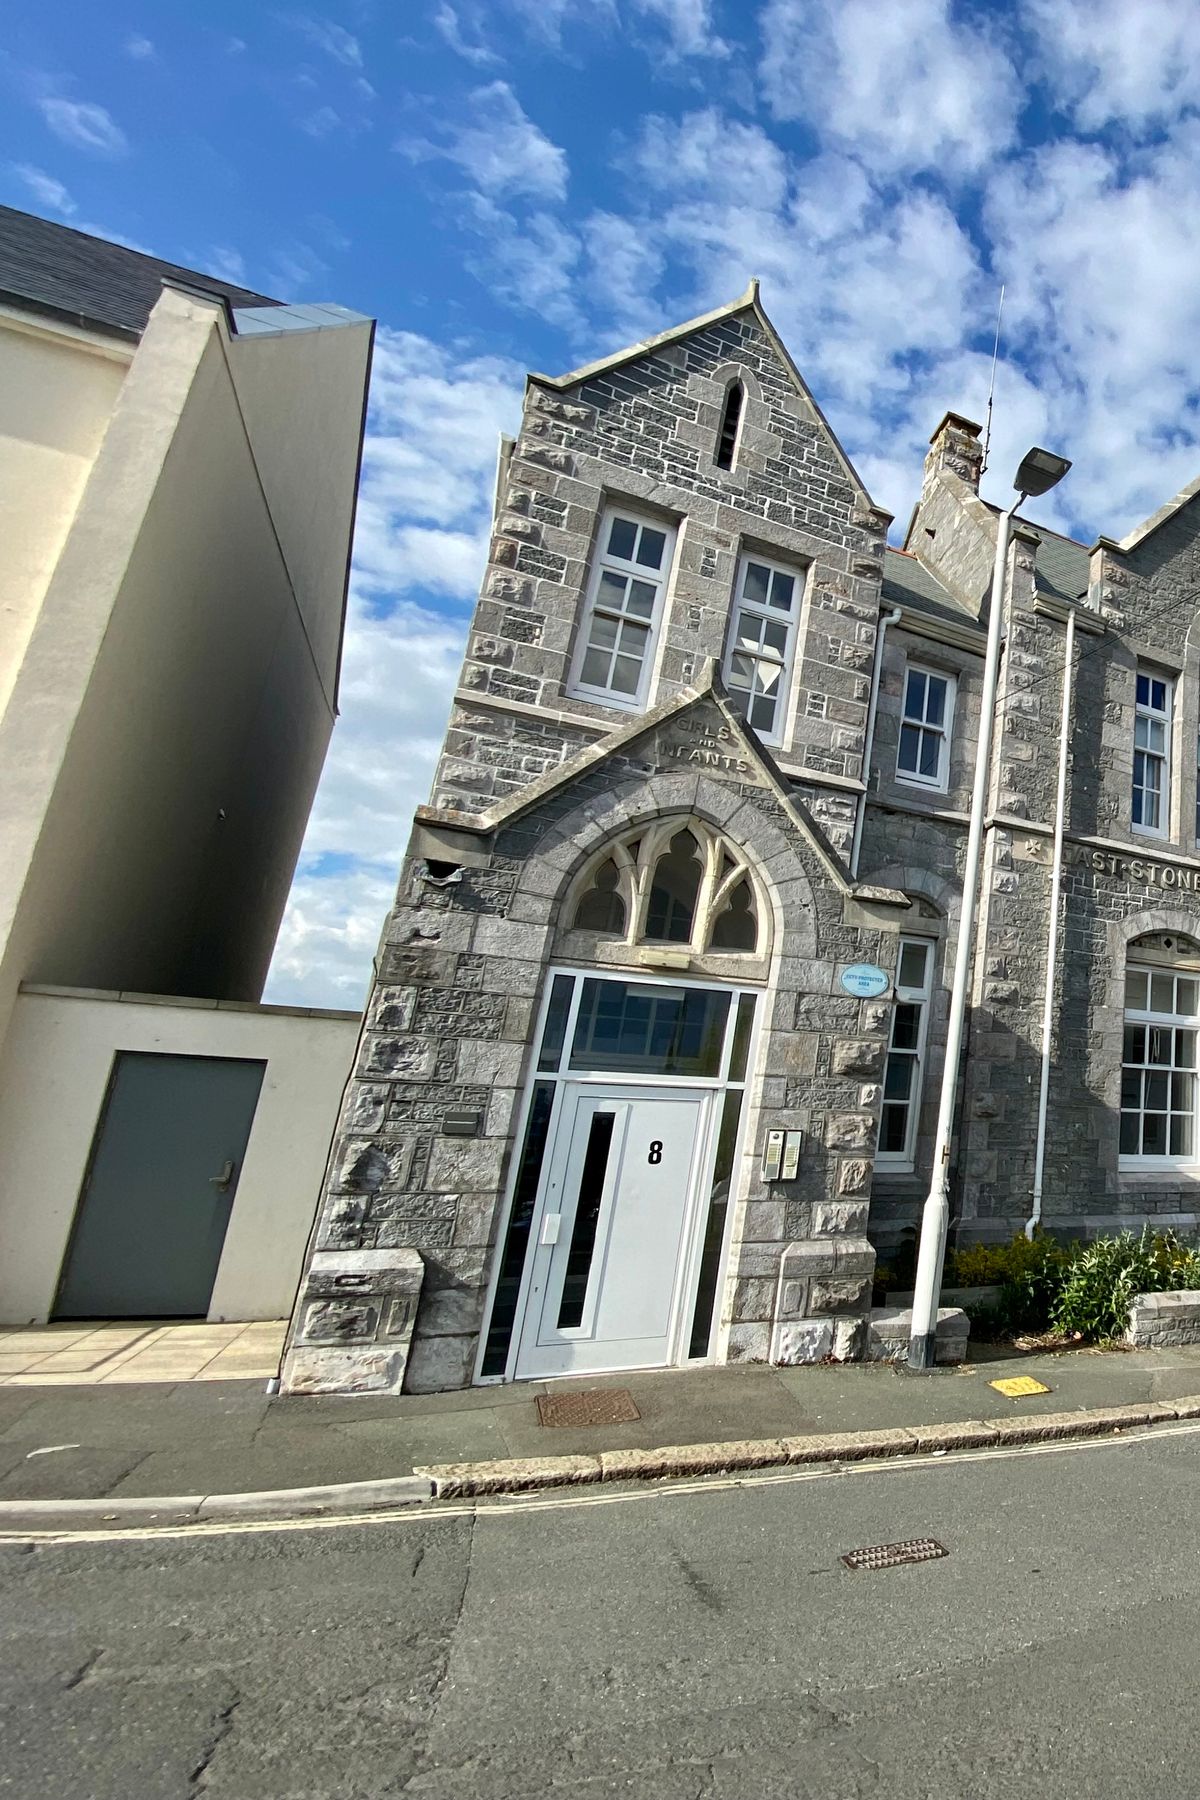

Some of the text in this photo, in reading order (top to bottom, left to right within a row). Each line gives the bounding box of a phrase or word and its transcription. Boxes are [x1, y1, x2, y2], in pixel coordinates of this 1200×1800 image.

[676, 717, 731, 740] GIRLS
[689, 738, 717, 748] AND
[1062, 843, 1122, 874] EAST
[648, 1140, 663, 1165] 8
